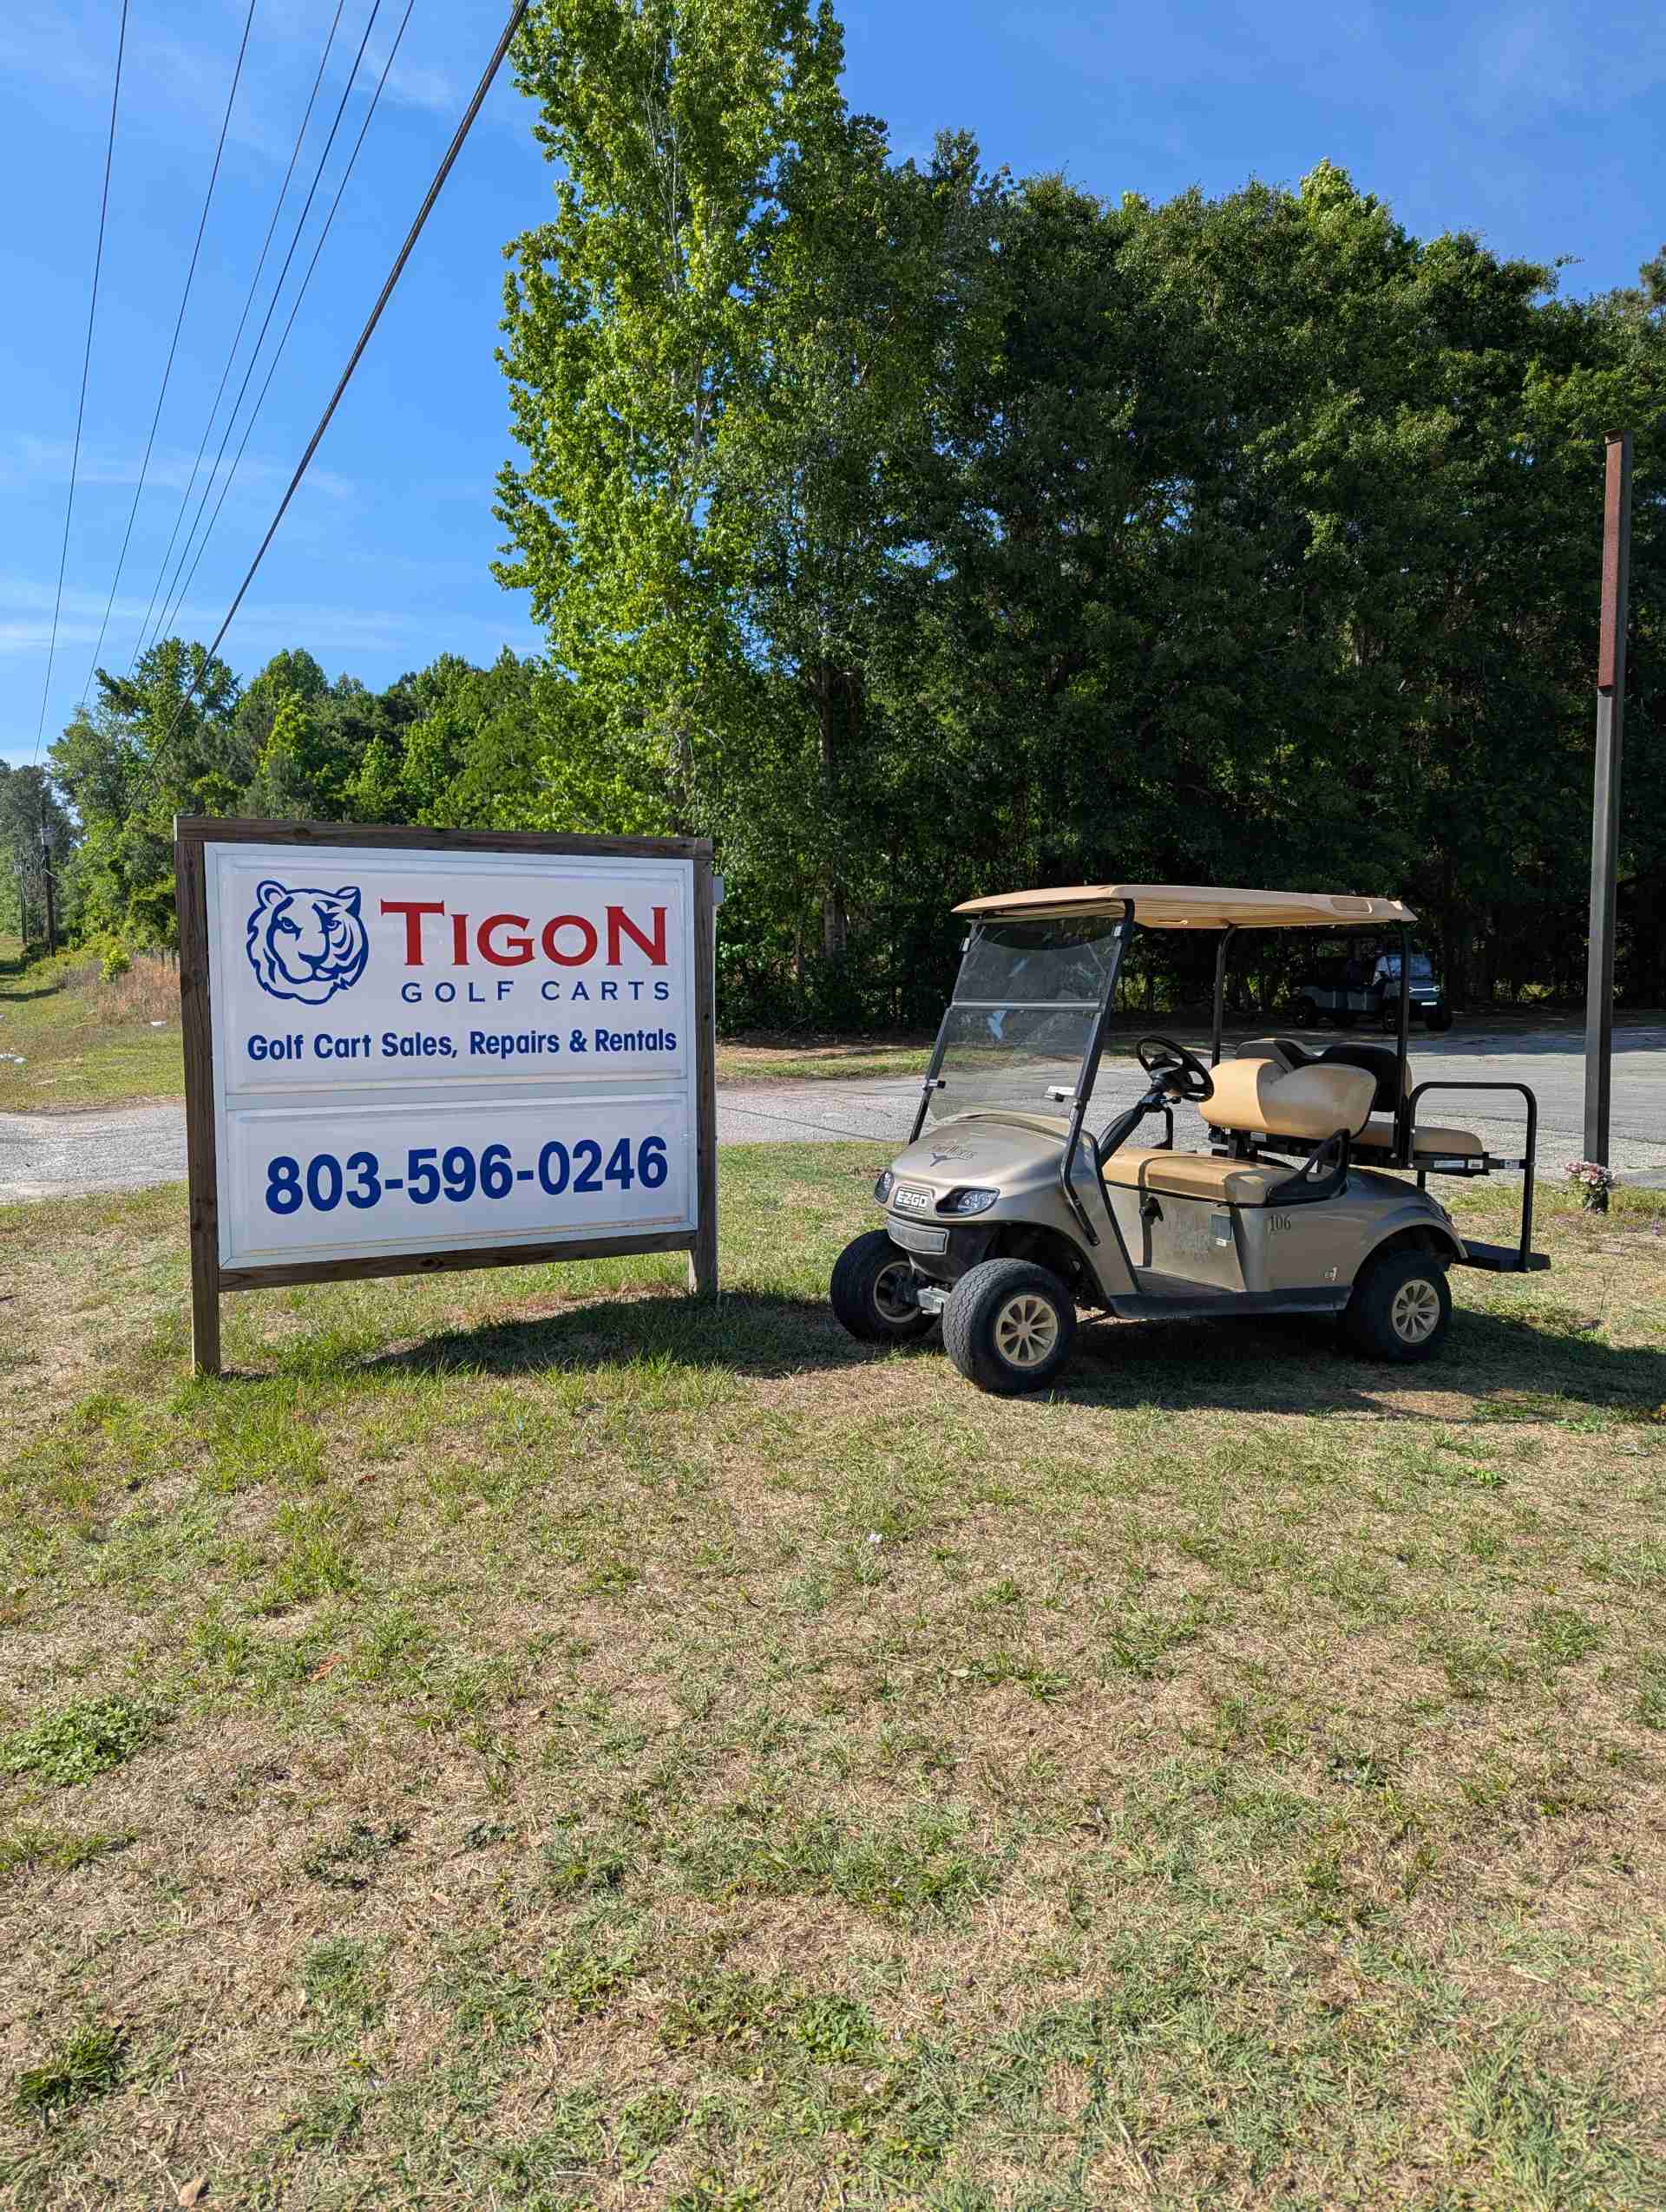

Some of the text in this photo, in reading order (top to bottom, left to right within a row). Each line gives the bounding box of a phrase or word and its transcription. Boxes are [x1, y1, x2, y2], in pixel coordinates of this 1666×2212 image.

[380, 899, 668, 966] TIGON
[401, 980, 670, 1003] GOLF CARTS
[247, 1028, 678, 1061] Golf Cart Sales, Repairs & Rentals
[265, 1135, 668, 1215] 803-596-0246
[1269, 1214, 1291, 1231] 106
